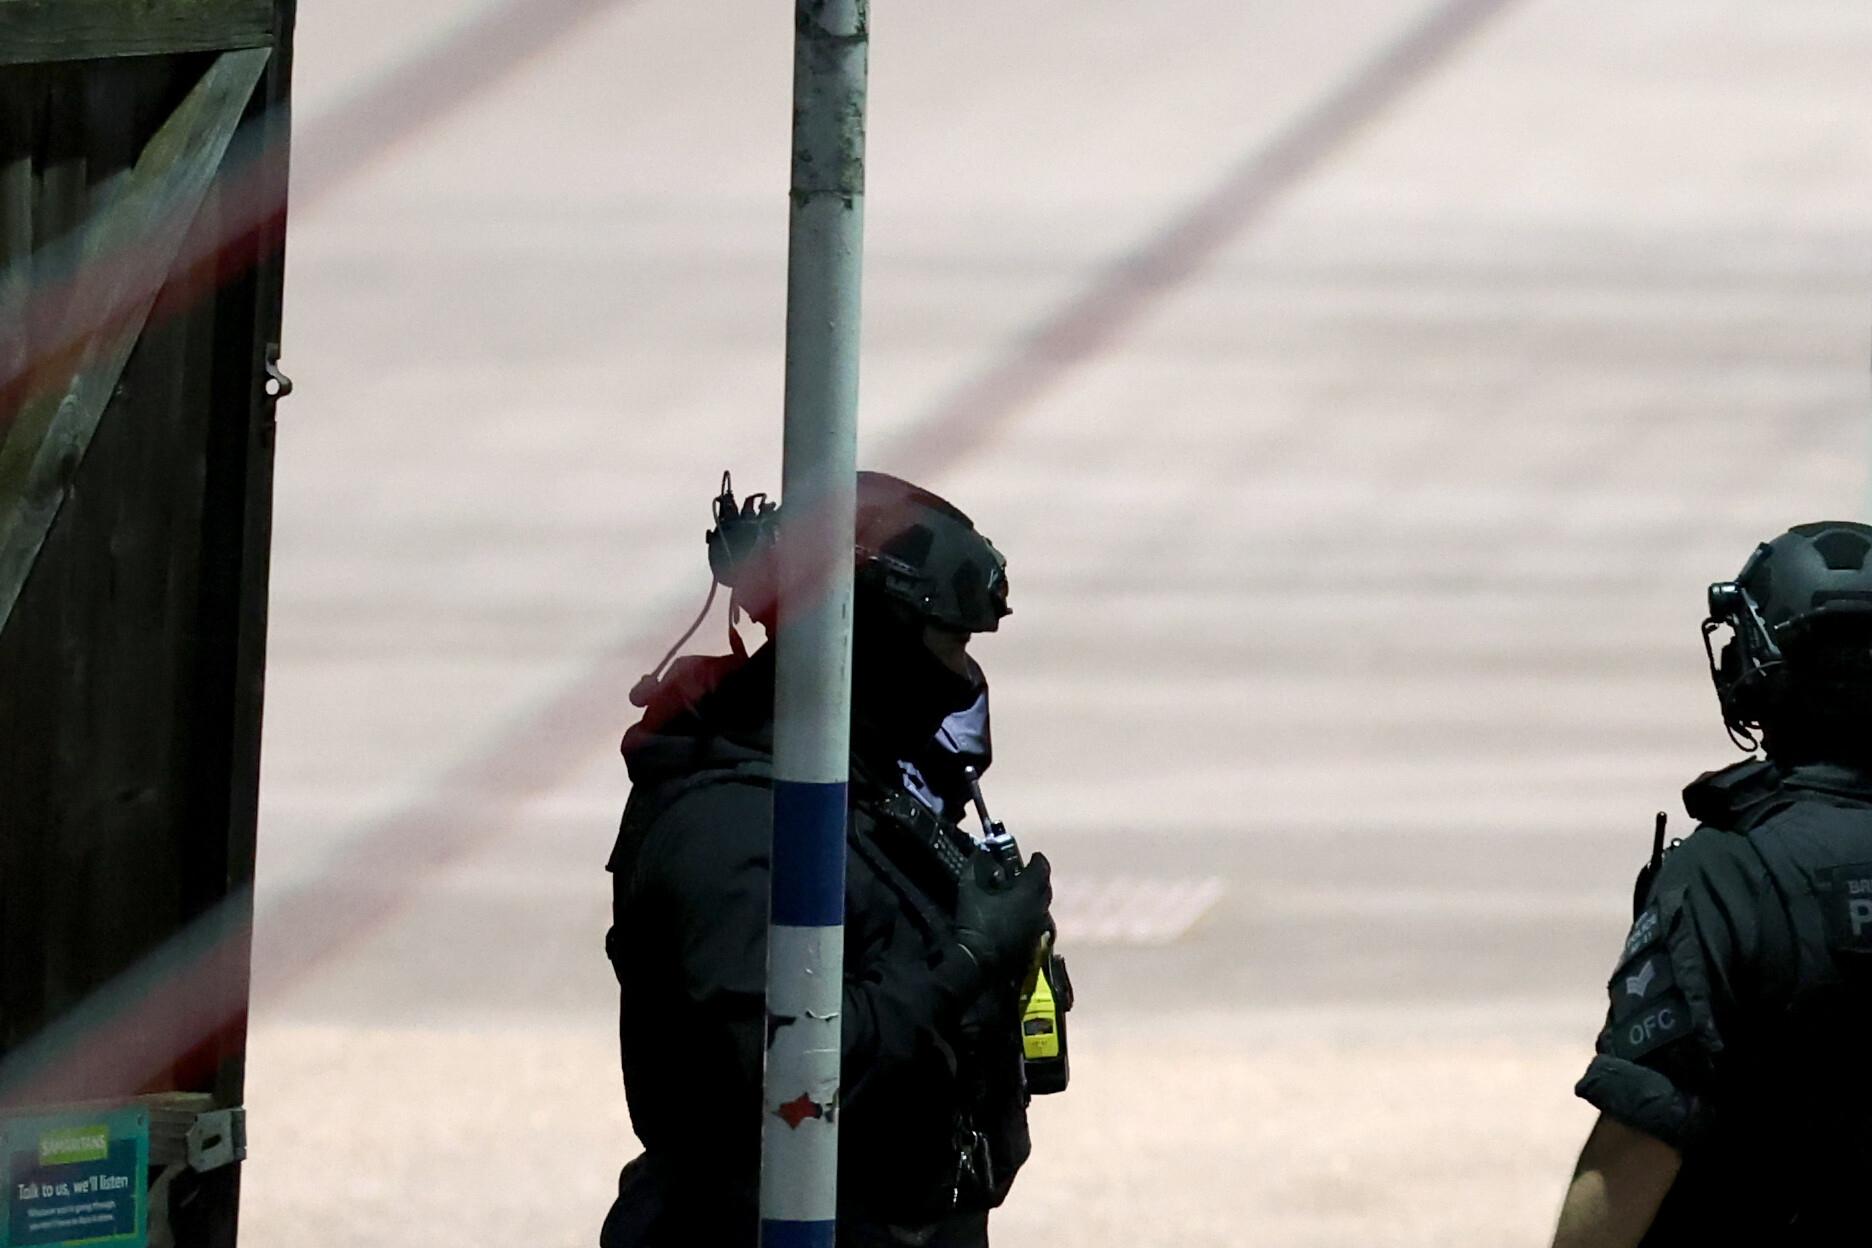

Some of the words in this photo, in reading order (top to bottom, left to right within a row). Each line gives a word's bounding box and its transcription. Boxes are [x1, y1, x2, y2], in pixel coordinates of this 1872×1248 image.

[1629, 1008, 1676, 1045] OFC
[18, 1182, 39, 1201] Talk
[42, 1183, 54, 1198] to
[55, 1183, 70, 1198] us,
[73, 1176, 98, 1194] we'll
[99, 1174, 129, 1191] listen
